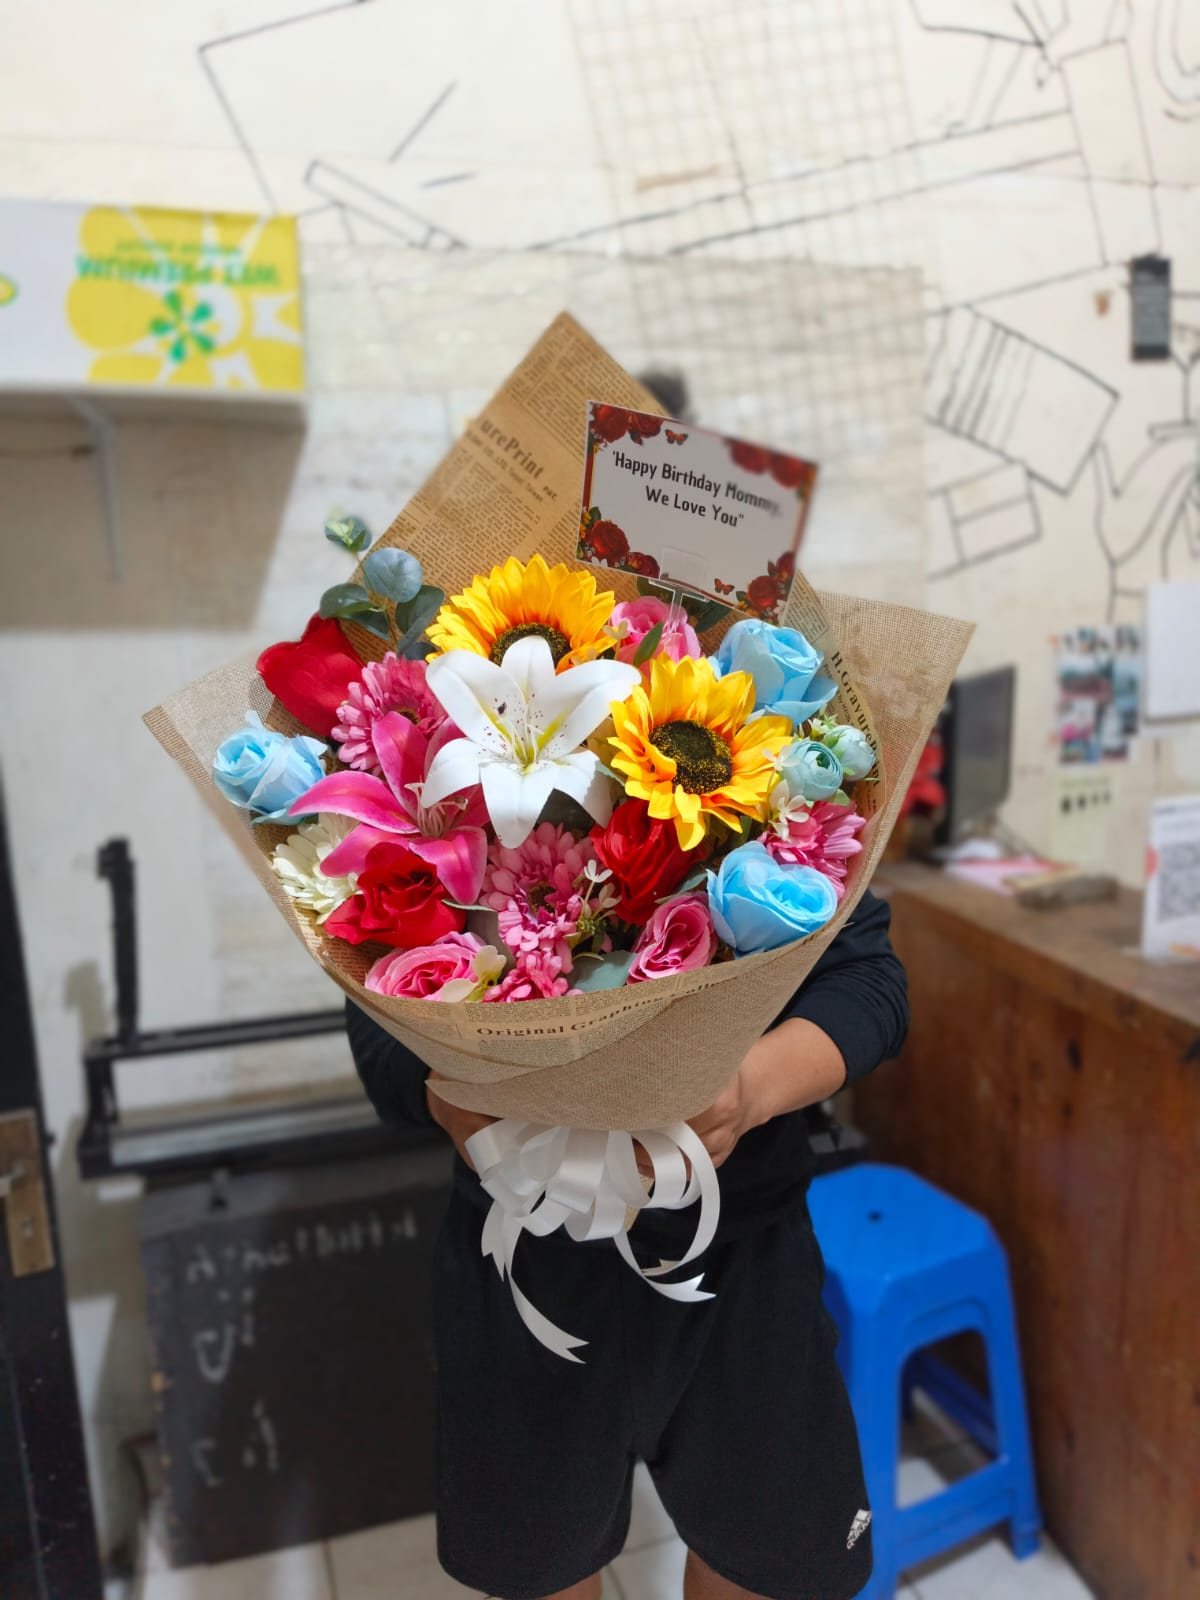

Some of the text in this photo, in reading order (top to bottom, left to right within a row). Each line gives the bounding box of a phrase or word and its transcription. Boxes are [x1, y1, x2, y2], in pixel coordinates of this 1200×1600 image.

[661, 463, 721, 498] Birthday
[646, 486, 670, 506] We
[674, 494, 706, 517] Love
[477, 1025, 564, 1037] Original
